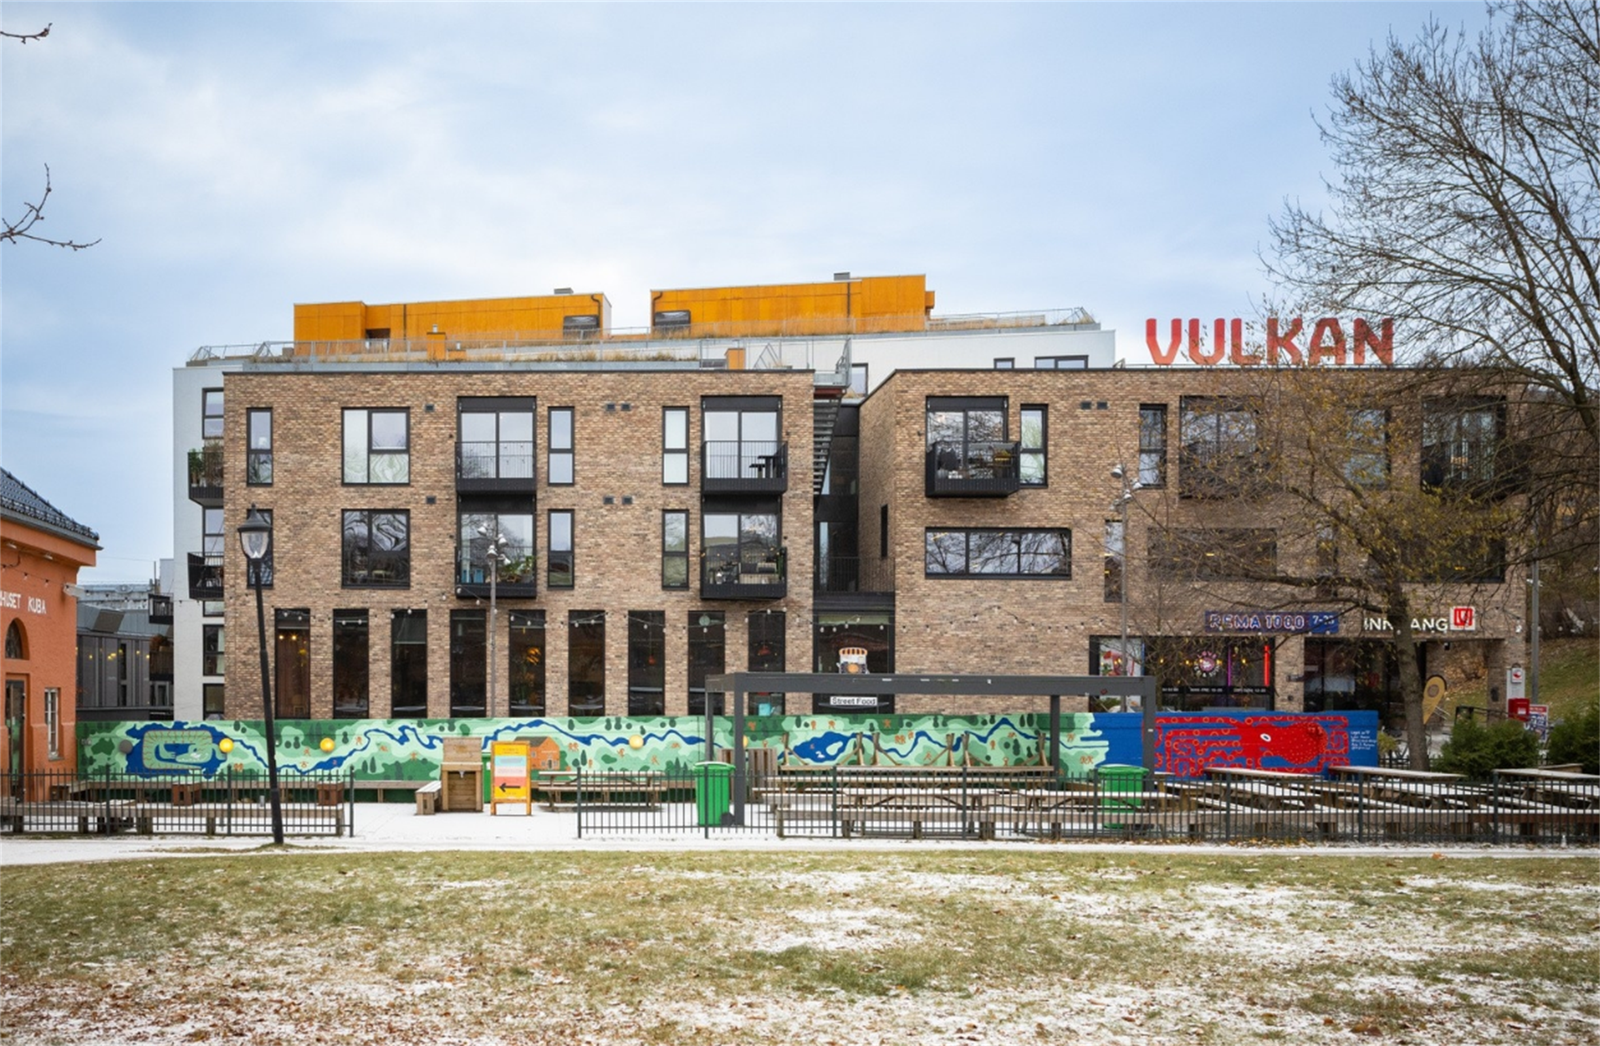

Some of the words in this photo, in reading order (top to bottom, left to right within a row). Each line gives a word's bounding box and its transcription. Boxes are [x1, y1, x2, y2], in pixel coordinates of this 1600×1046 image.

[1145, 317, 1394, 366] VULKAN
[27, 596, 47, 615] KUBA
[1210, 613, 1260, 629] REMA
[1265, 613, 1305, 630] 1000
[1364, 616, 1449, 632] INNANG
[832, 696, 855, 705] Street
[856, 696, 876, 705] Food
